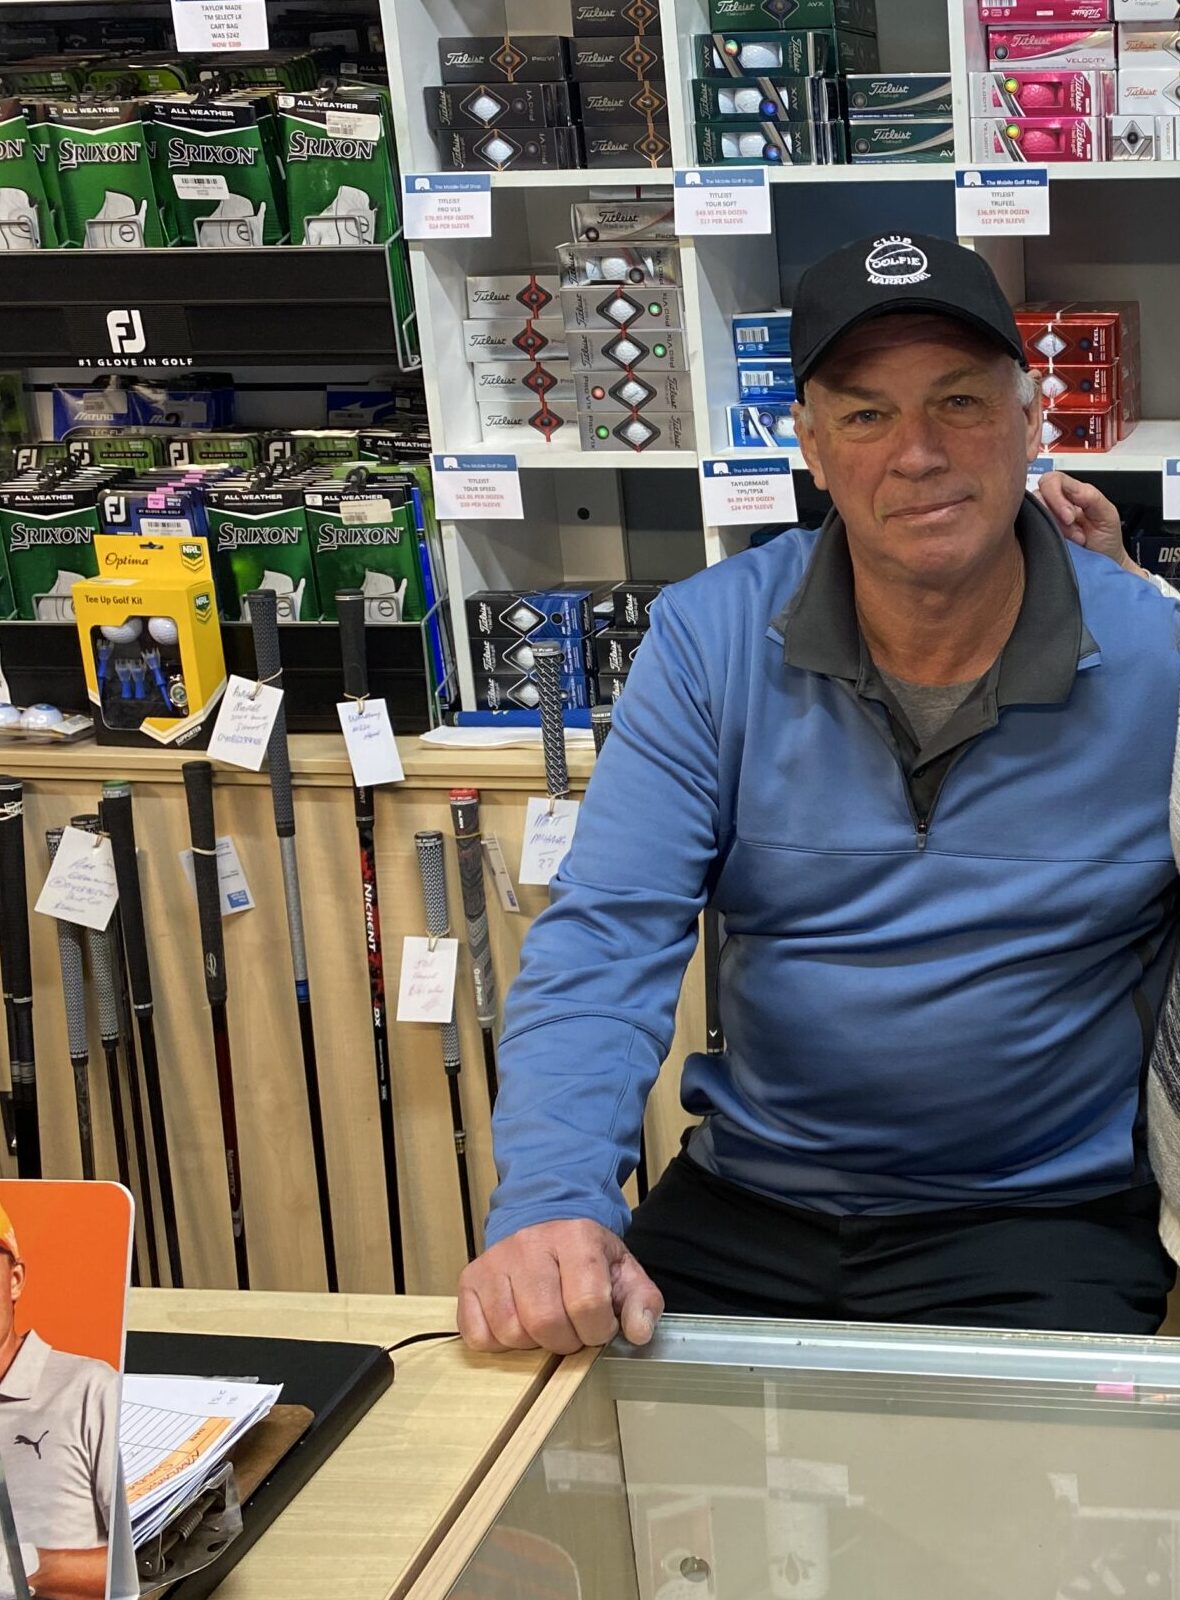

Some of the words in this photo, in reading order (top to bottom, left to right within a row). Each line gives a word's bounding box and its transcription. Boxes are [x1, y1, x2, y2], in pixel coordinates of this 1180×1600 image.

[576, 6, 616, 20] Titleist
[714, 0, 755, 14] Titleist
[445, 51, 485, 66] Titleist
[575, 51, 615, 66] Titleist
[868, 81, 910, 95] Titleist
[315, 101, 359, 110] WEATHER
[585, 95, 625, 109] Titleist
[79, 106, 120, 114] WEATHER
[171, 107, 187, 115] ALL
[189, 109, 234, 117] WEATHER
[871, 127, 912, 141] Titleist
[168, 137, 255, 169] SRIXON
[287, 130, 374, 163] SRIXON
[590, 140, 629, 153] Titleist
[58, 137, 140, 172] SRIXON
[597, 210, 640, 225] Titleist
[873, 235, 912, 248] CLUB
[472, 290, 511, 303] Titleist
[106, 309, 146, 354] FJ
[469, 334, 507, 346] Titleist
[78, 358, 91, 366] #1
[97, 358, 138, 366] GLOVE
[143, 358, 157, 366] IN
[161, 358, 193, 366] GOLF
[479, 374, 517, 386] Titleist
[485, 415, 523, 427] Titleist
[104, 496, 126, 523] FJ
[10, 522, 92, 552] SRIXON
[217, 521, 300, 552] SRIXON
[317, 523, 400, 553] SRIXON
[182, 545, 202, 555] NRL
[104, 552, 149, 570] Optima
[85, 595, 99, 603] Tee
[100, 595, 111, 604] Up
[112, 595, 129, 604] Golf
[131, 596, 143, 605] Kit
[363, 883, 377, 953] NICKENT
